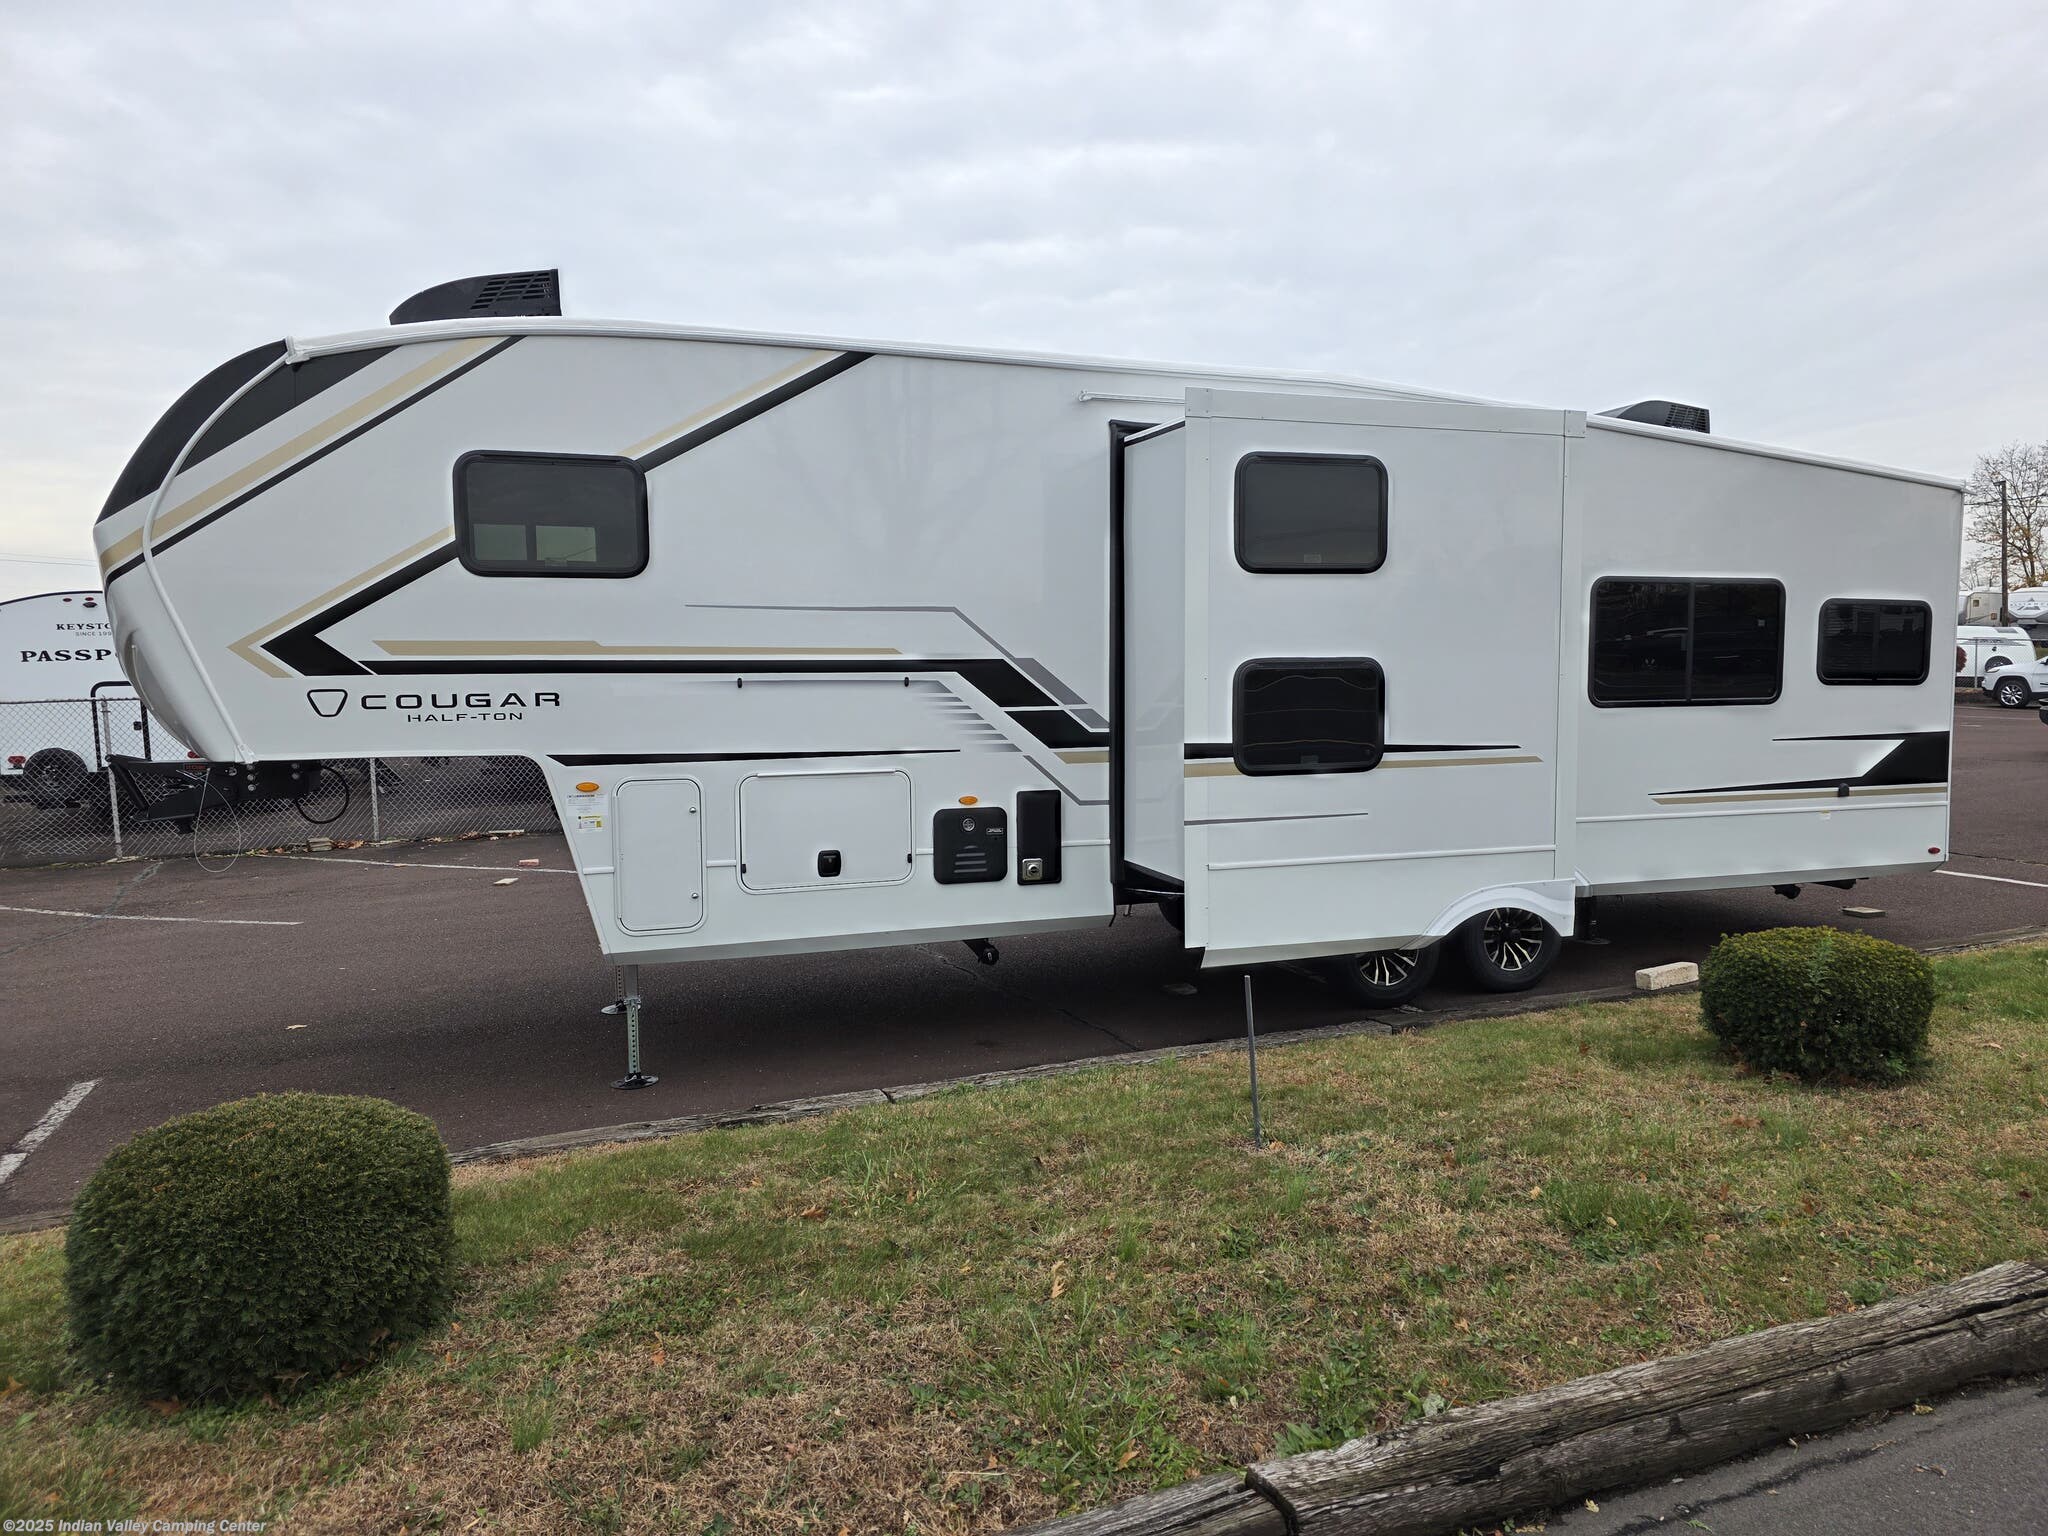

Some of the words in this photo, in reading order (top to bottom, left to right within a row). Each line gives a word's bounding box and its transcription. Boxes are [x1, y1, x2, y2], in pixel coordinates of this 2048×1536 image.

[20, 648, 119, 663] PASSP
[361, 692, 560, 710] COUGAR
[407, 712, 523, 723] HALF-TON
